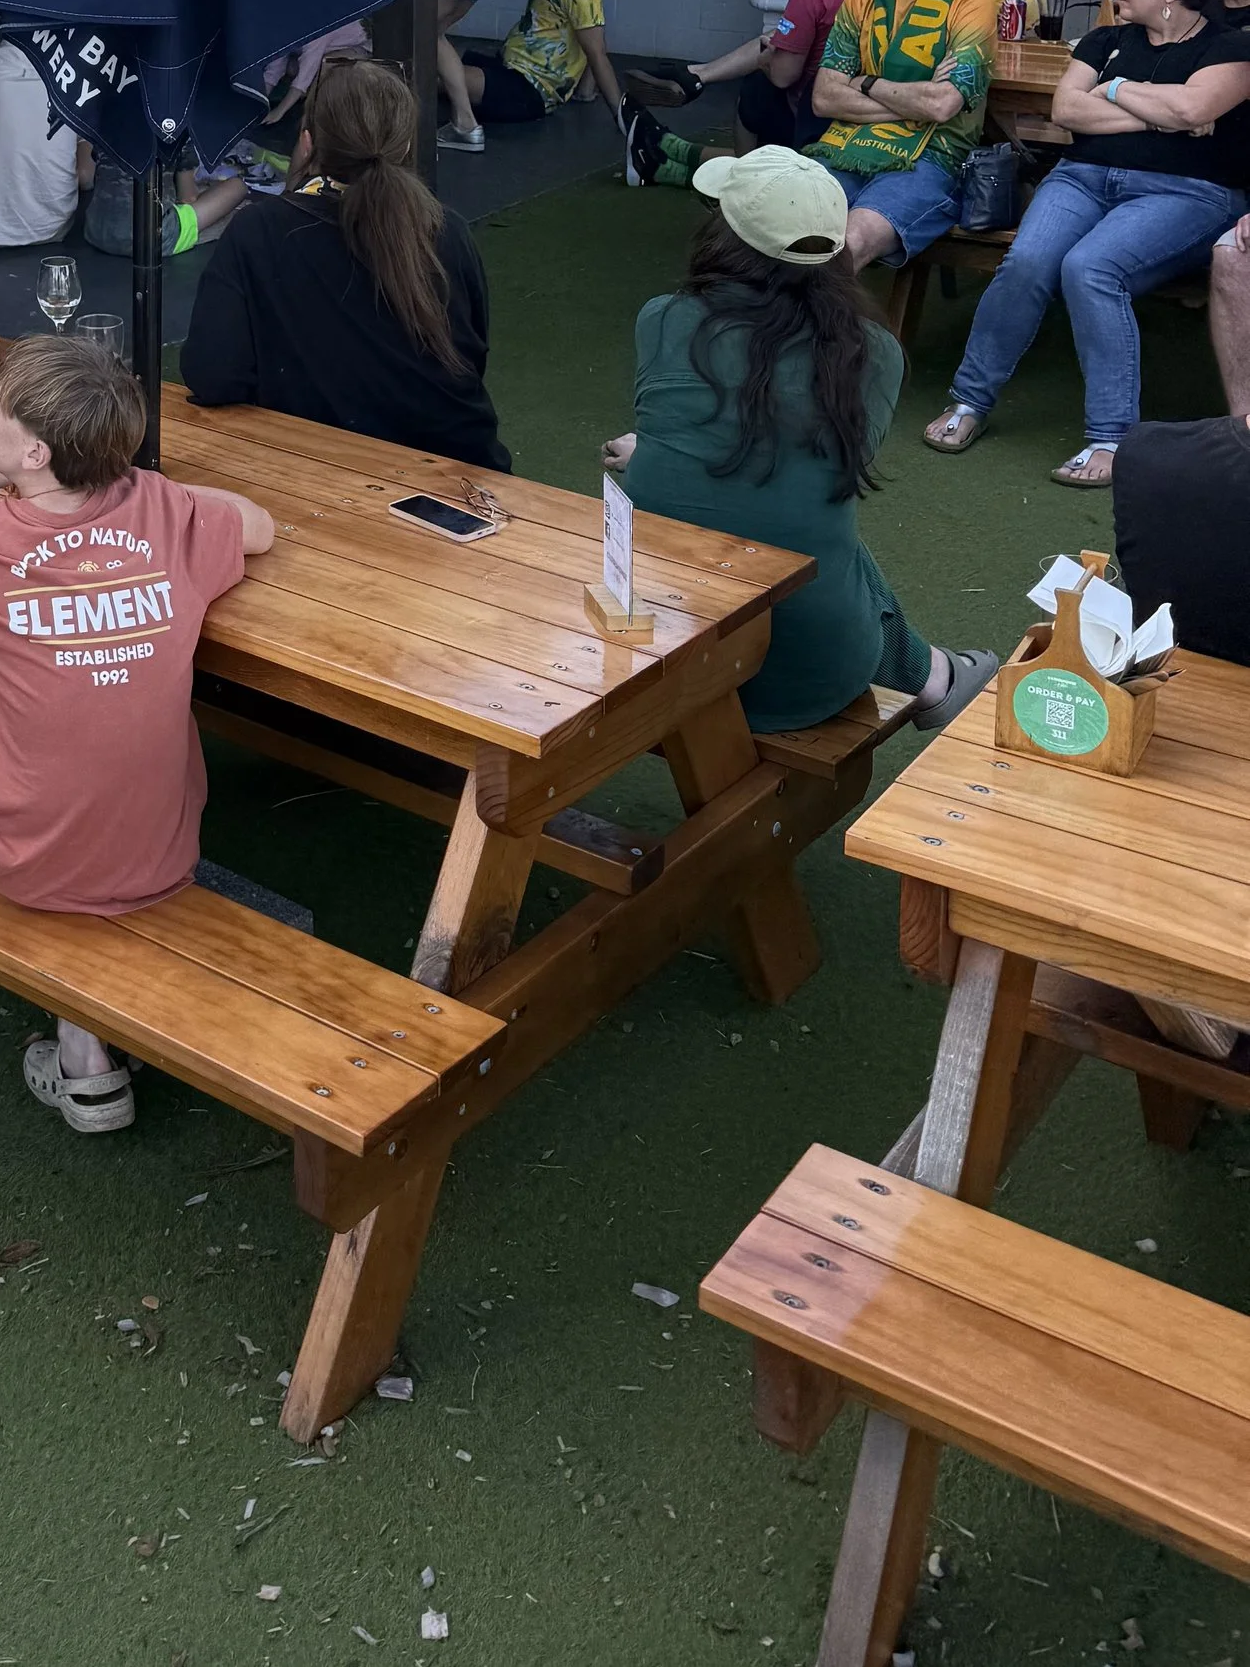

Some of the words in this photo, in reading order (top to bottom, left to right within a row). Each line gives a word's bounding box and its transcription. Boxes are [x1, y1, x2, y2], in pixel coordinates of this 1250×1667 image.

[78, 34, 139, 94] BAY
[852, 138, 909, 159] AUSTRALIA
[54, 530, 84, 552] TO
[7, 581, 174, 636] ELEMENT
[55, 642, 154, 666] ESTABLISHED
[91, 668, 129, 686] 1992
[1027, 685, 1063, 701] ORDER
[1075, 696, 1096, 708] PAY
